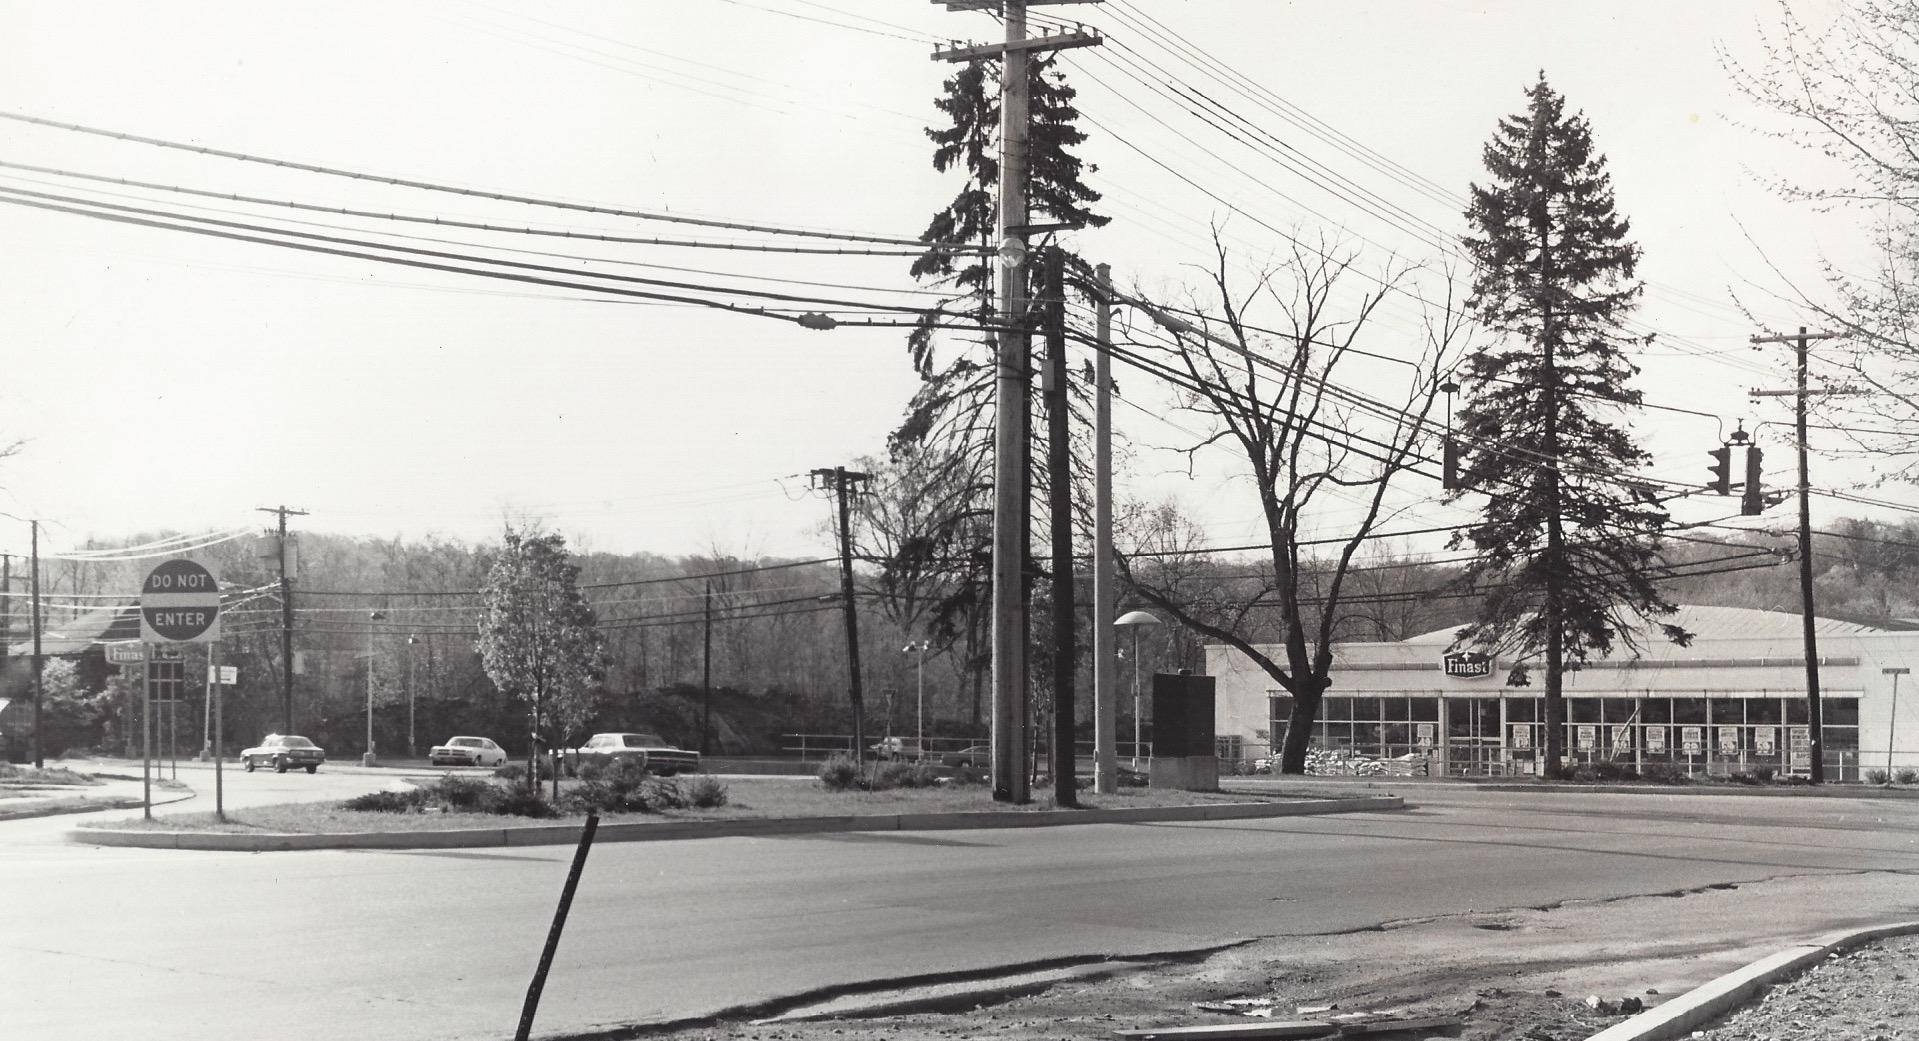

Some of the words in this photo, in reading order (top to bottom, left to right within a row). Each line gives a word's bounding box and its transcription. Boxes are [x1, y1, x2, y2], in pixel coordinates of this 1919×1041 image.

[152, 574, 172, 588] DO
[177, 574, 207, 588] NOT
[155, 612, 205, 626] ENTER
[113, 647, 146, 661] Finas
[1447, 658, 1487, 674] Finast
